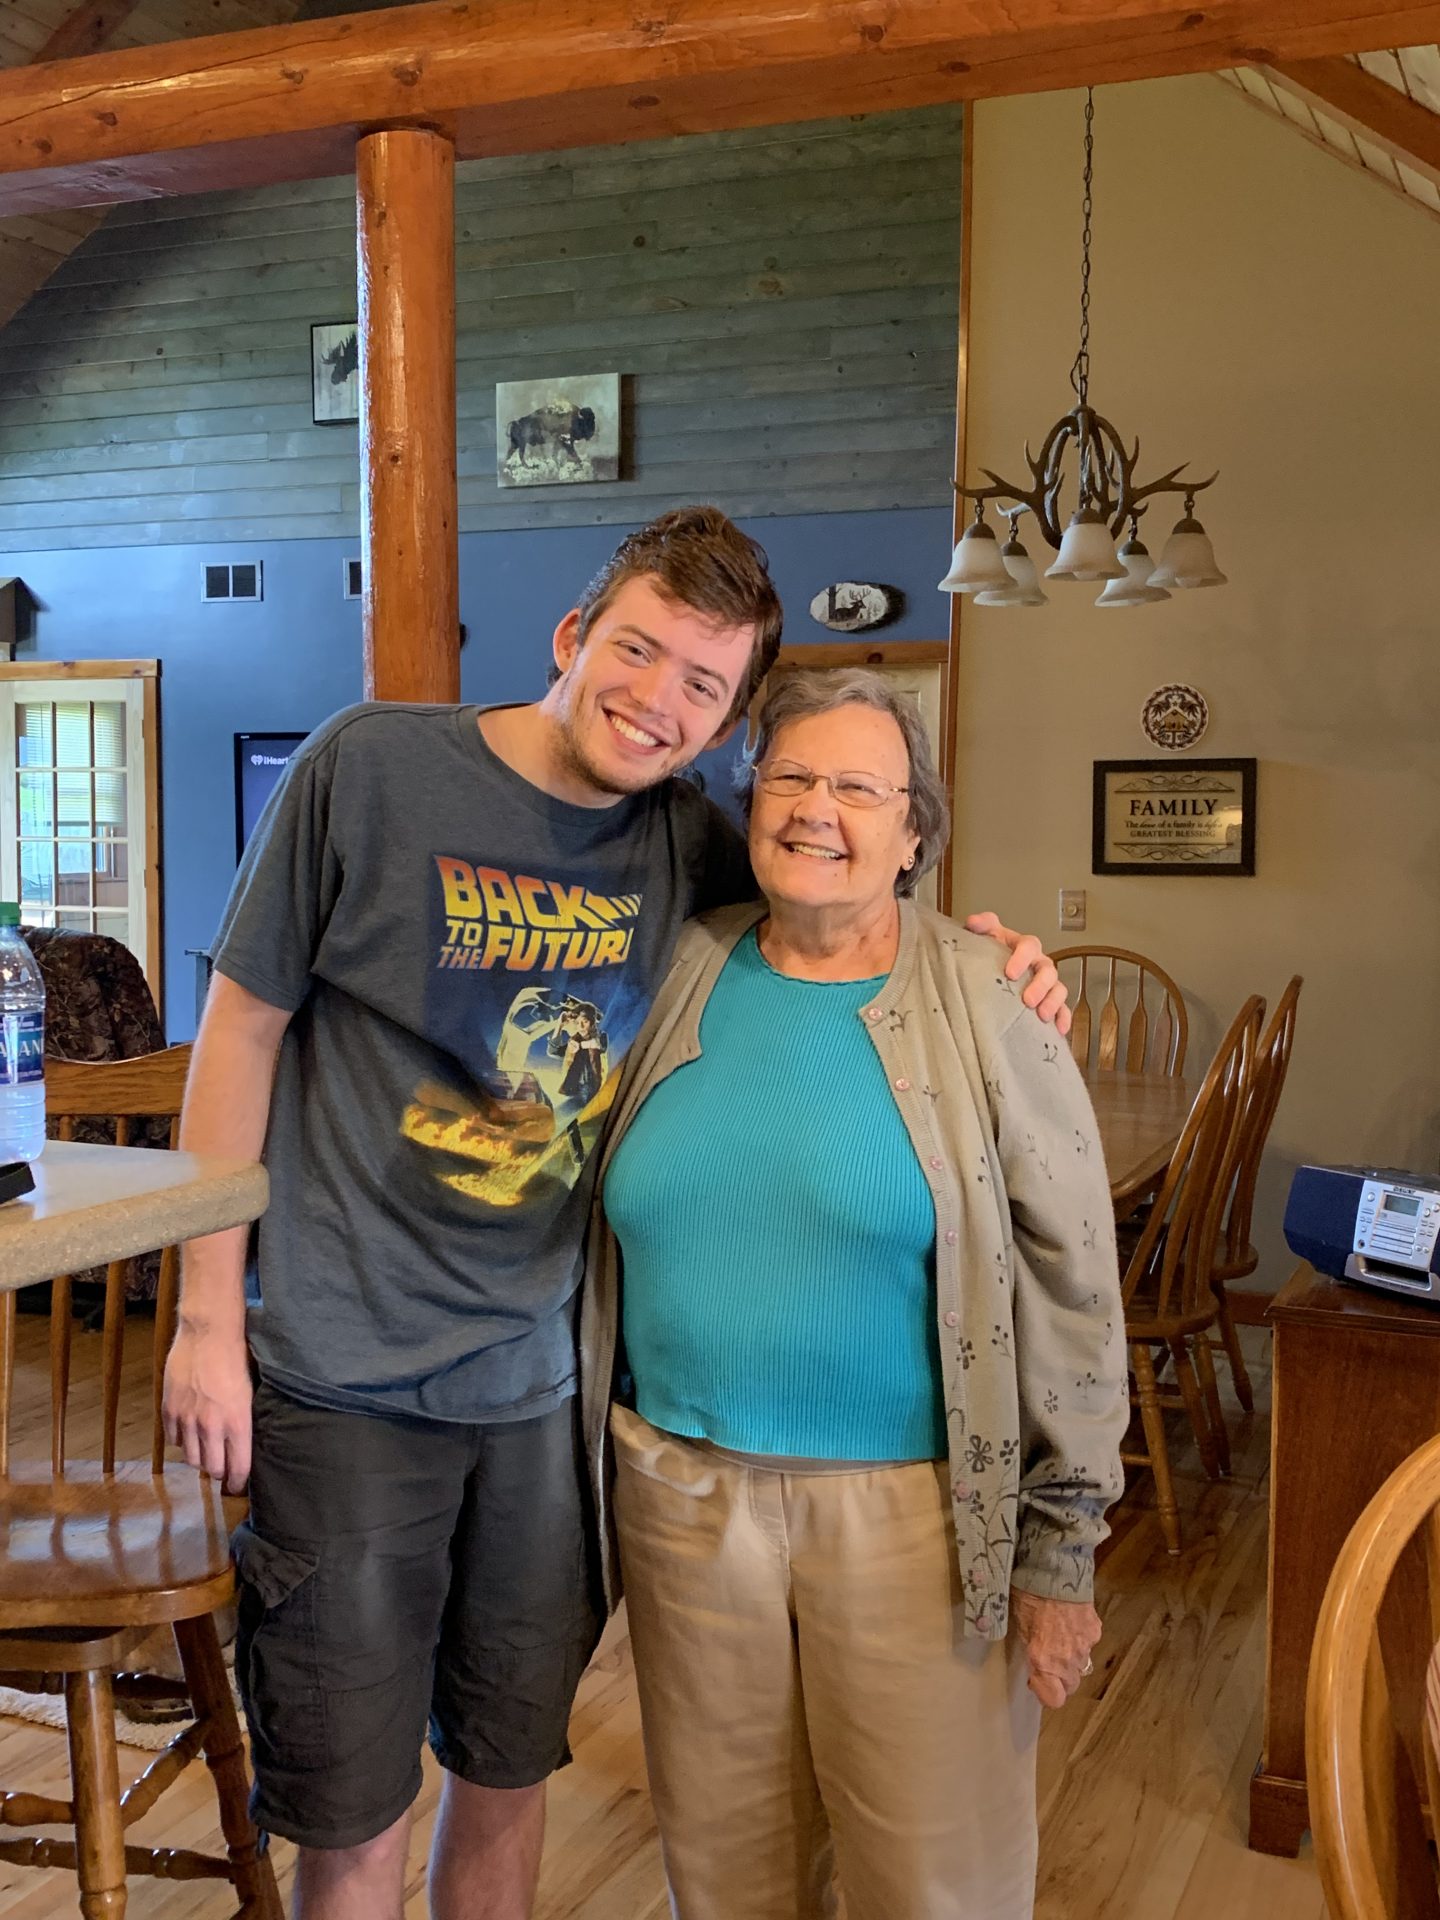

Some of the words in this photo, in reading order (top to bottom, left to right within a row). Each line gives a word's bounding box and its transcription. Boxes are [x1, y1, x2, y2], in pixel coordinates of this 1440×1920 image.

[1130, 799, 1218, 815] FAMILY
[1125, 820, 1138, 829] The
[1173, 820, 1195, 830] family
[1130, 830, 1173, 838] GREATEST
[1175, 830, 1216, 838] BLESSING
[434, 854, 642, 929] BACK
[446, 918, 483, 947] TO
[436, 945, 483, 969] THE
